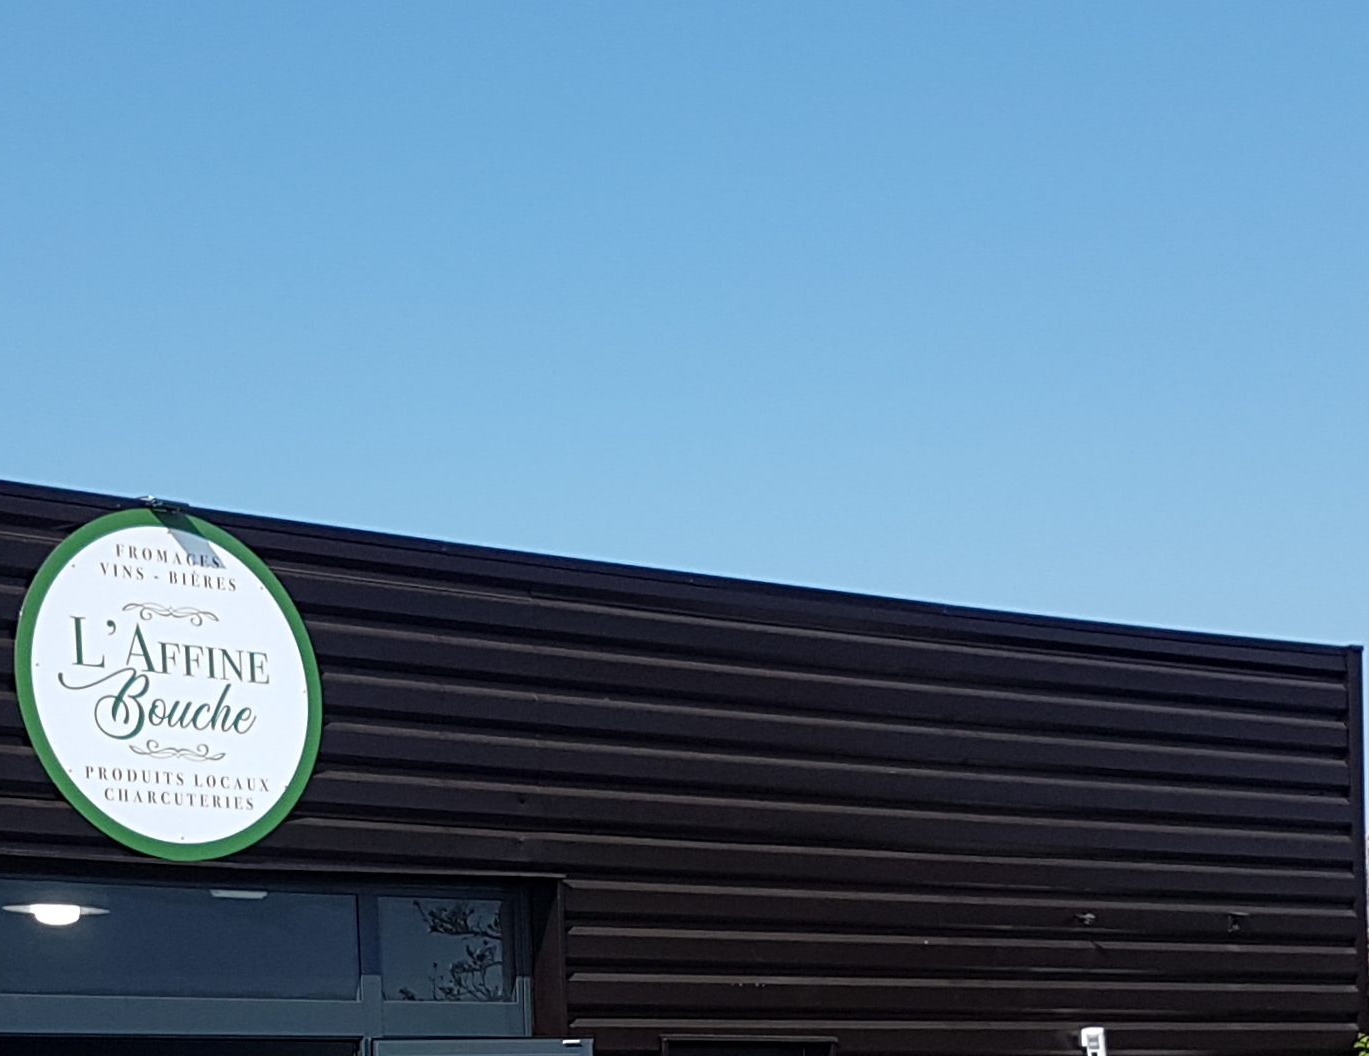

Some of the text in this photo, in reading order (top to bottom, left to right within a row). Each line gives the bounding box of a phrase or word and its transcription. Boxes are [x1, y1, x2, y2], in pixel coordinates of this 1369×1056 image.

[115, 543, 221, 569] FROMAGES
[100, 562, 145, 580] VINS
[168, 570, 238, 592] BIÈRES
[57, 667, 258, 740] Bouche
[85, 765, 271, 793] PRODUITS LOCAUX
[104, 787, 255, 811] CHARCUTERIES
